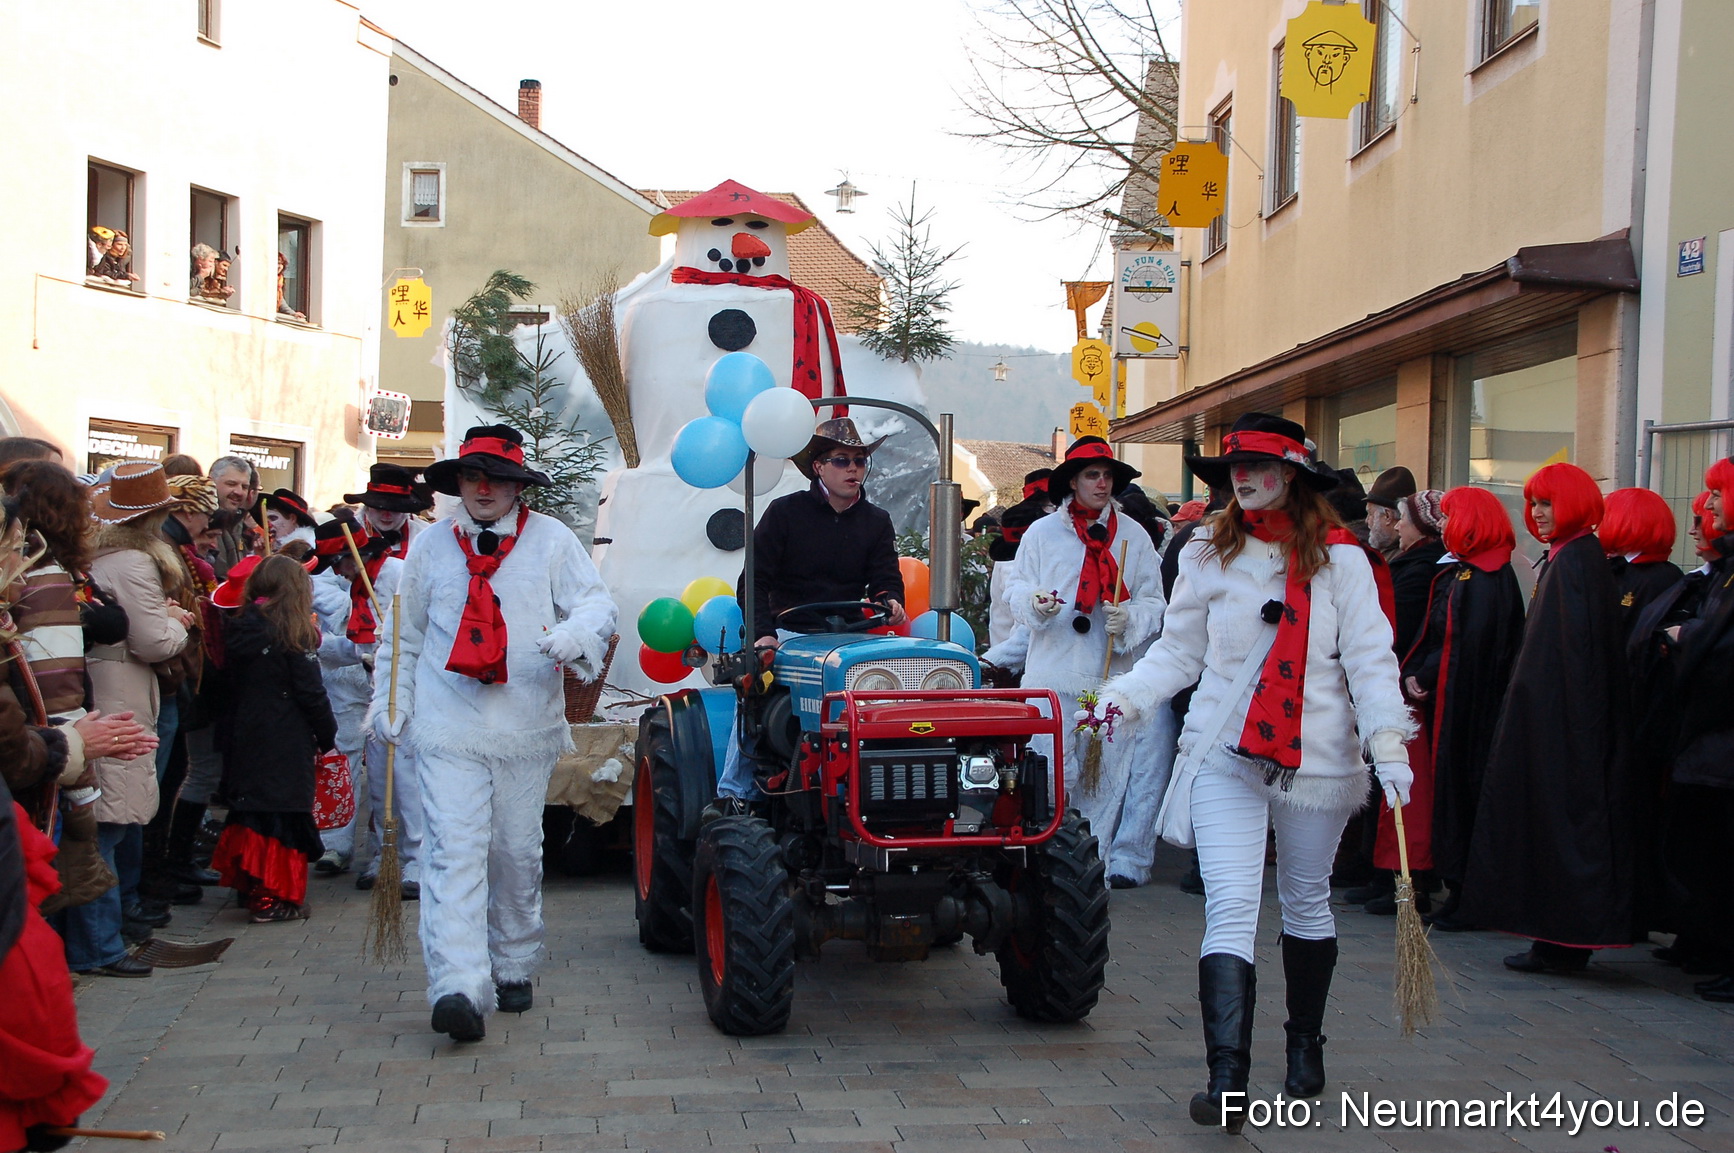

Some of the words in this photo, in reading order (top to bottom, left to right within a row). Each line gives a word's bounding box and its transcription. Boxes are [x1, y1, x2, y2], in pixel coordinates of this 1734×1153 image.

[1681, 240, 1700, 260] 42
[1121, 266, 1133, 283] FIT
[1134, 256, 1155, 266] FUN
[1156, 258, 1163, 266] &
[1163, 264, 1176, 284] SUN
[88, 438, 164, 459] DECHANT
